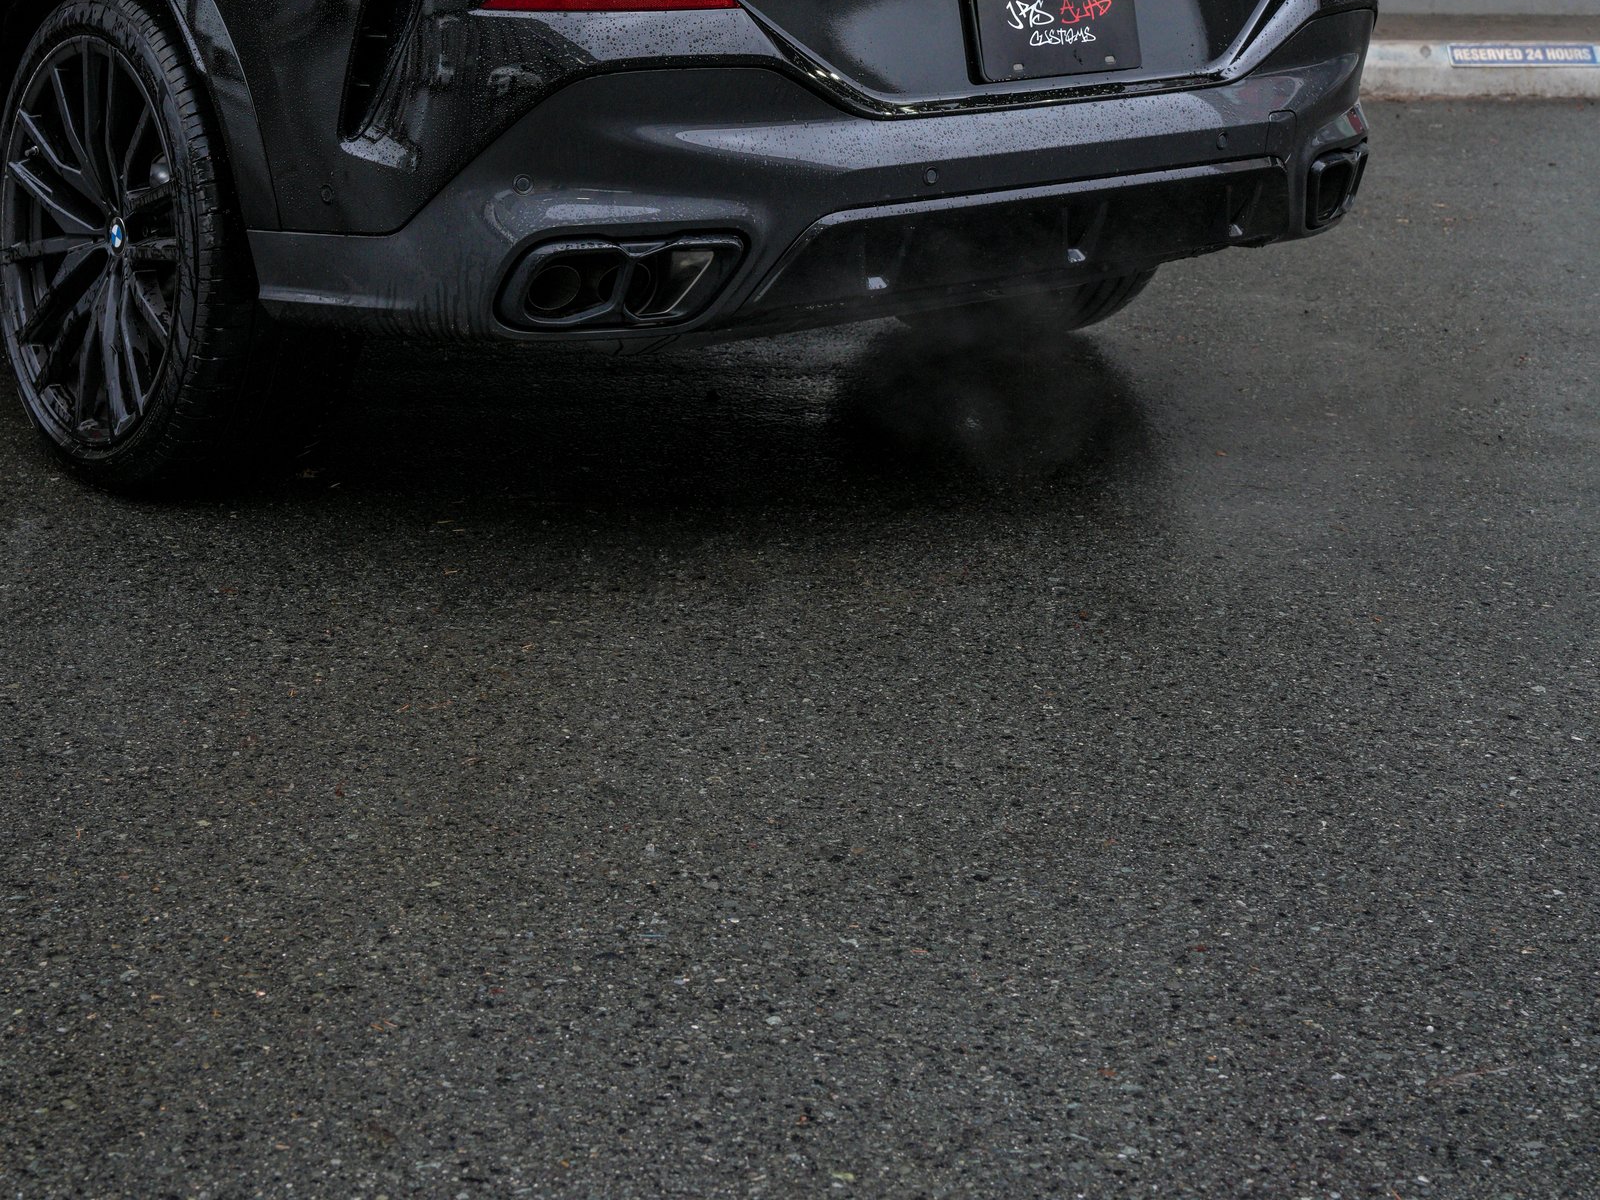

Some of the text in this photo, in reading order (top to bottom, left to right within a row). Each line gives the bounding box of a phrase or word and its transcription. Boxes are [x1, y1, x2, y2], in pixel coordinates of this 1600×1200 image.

[1029, 27, 1096, 47] CUSTOMS
[1453, 48, 1592, 61] RESERVED 24 HOURS
